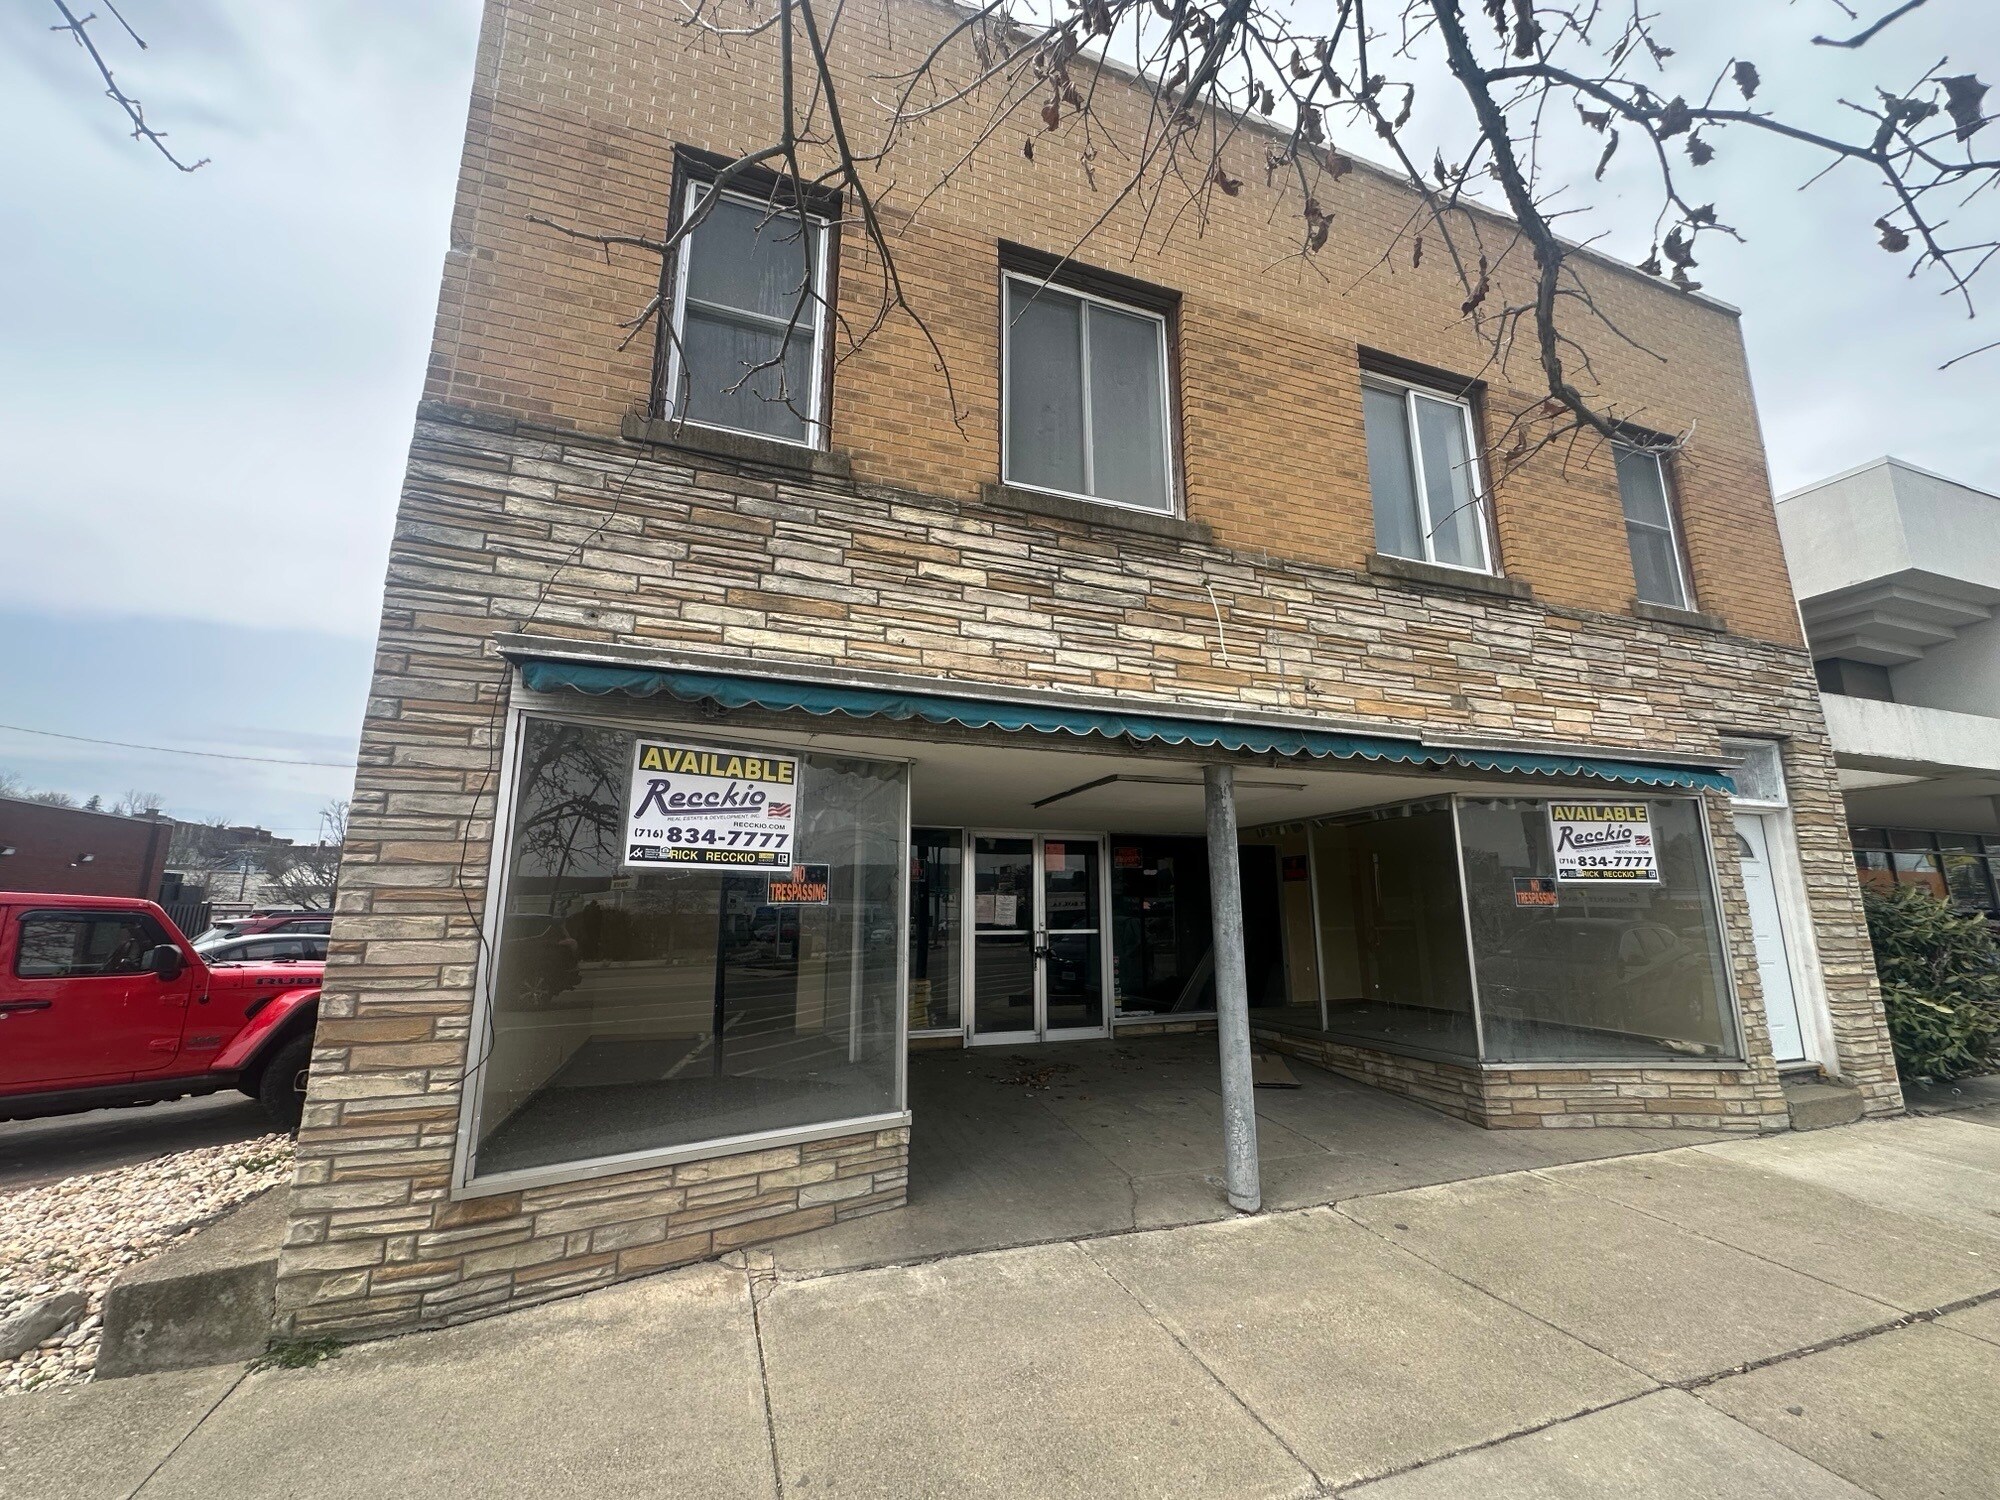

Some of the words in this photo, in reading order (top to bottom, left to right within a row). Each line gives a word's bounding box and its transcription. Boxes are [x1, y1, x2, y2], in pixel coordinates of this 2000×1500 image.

[642, 748, 793, 783] AVAILABLE
[634, 779, 766, 819] Recckio
[1554, 806, 1646, 821] AVAILABLE
[733, 822, 785, 830] RECCKIO.COM
[634, 828, 663, 838] (716)
[667, 827, 789, 848] 834-7777
[1557, 823, 1632, 852] Recckio
[670, 850, 698, 860] RICK
[706, 852, 756, 862] RECCKIO
[1578, 856, 1653, 867] 834-7777
[793, 866, 805, 882] NO
[771, 884, 826, 900] TRESPASSING
[1530, 880, 1539, 890] NO
[1517, 892, 1557, 904] TRESPASSING
